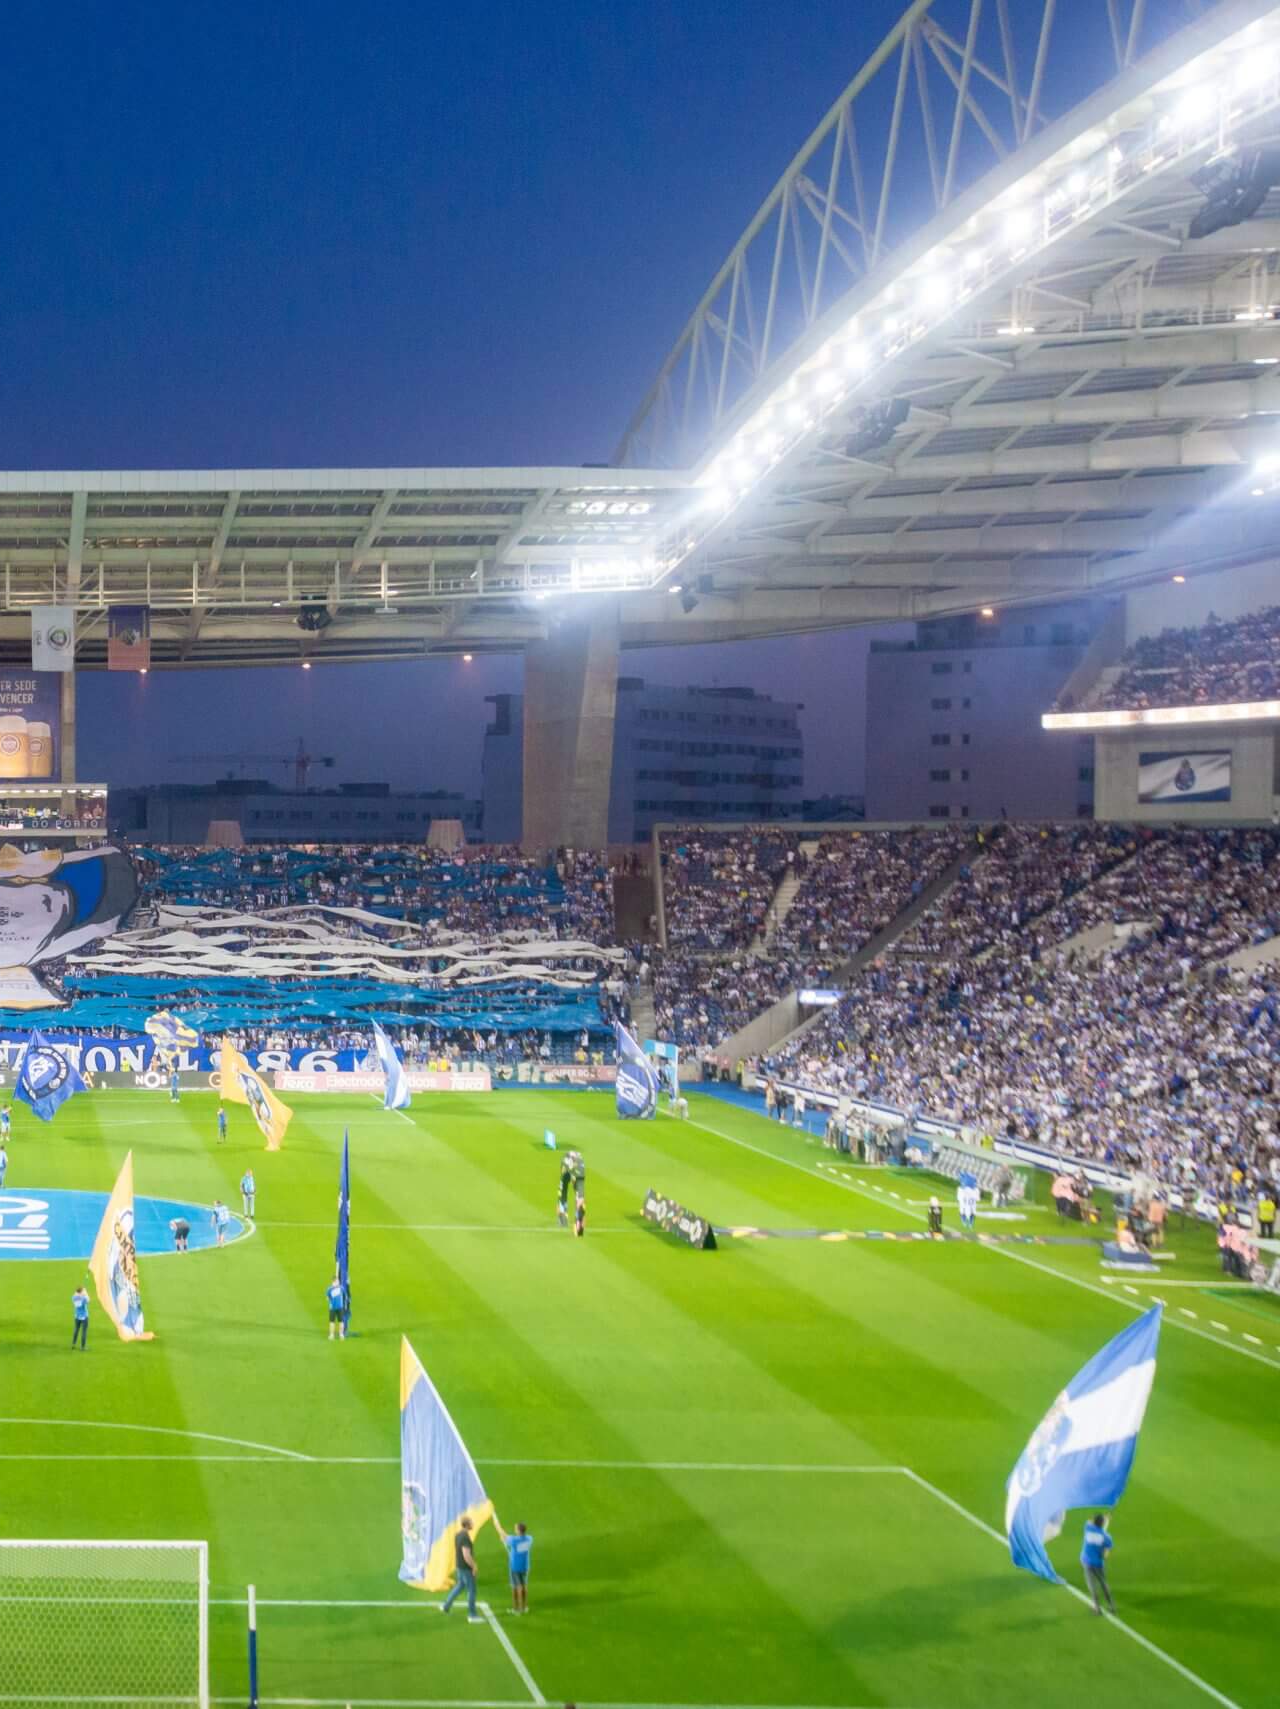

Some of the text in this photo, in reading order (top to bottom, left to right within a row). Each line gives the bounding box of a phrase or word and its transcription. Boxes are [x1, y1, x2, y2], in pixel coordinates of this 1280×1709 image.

[15, 680, 37, 691] SEDE
[0, 693, 34, 704] VENCER
[32, 820, 48, 829] DO
[135, 1071, 168, 1088] NOS
